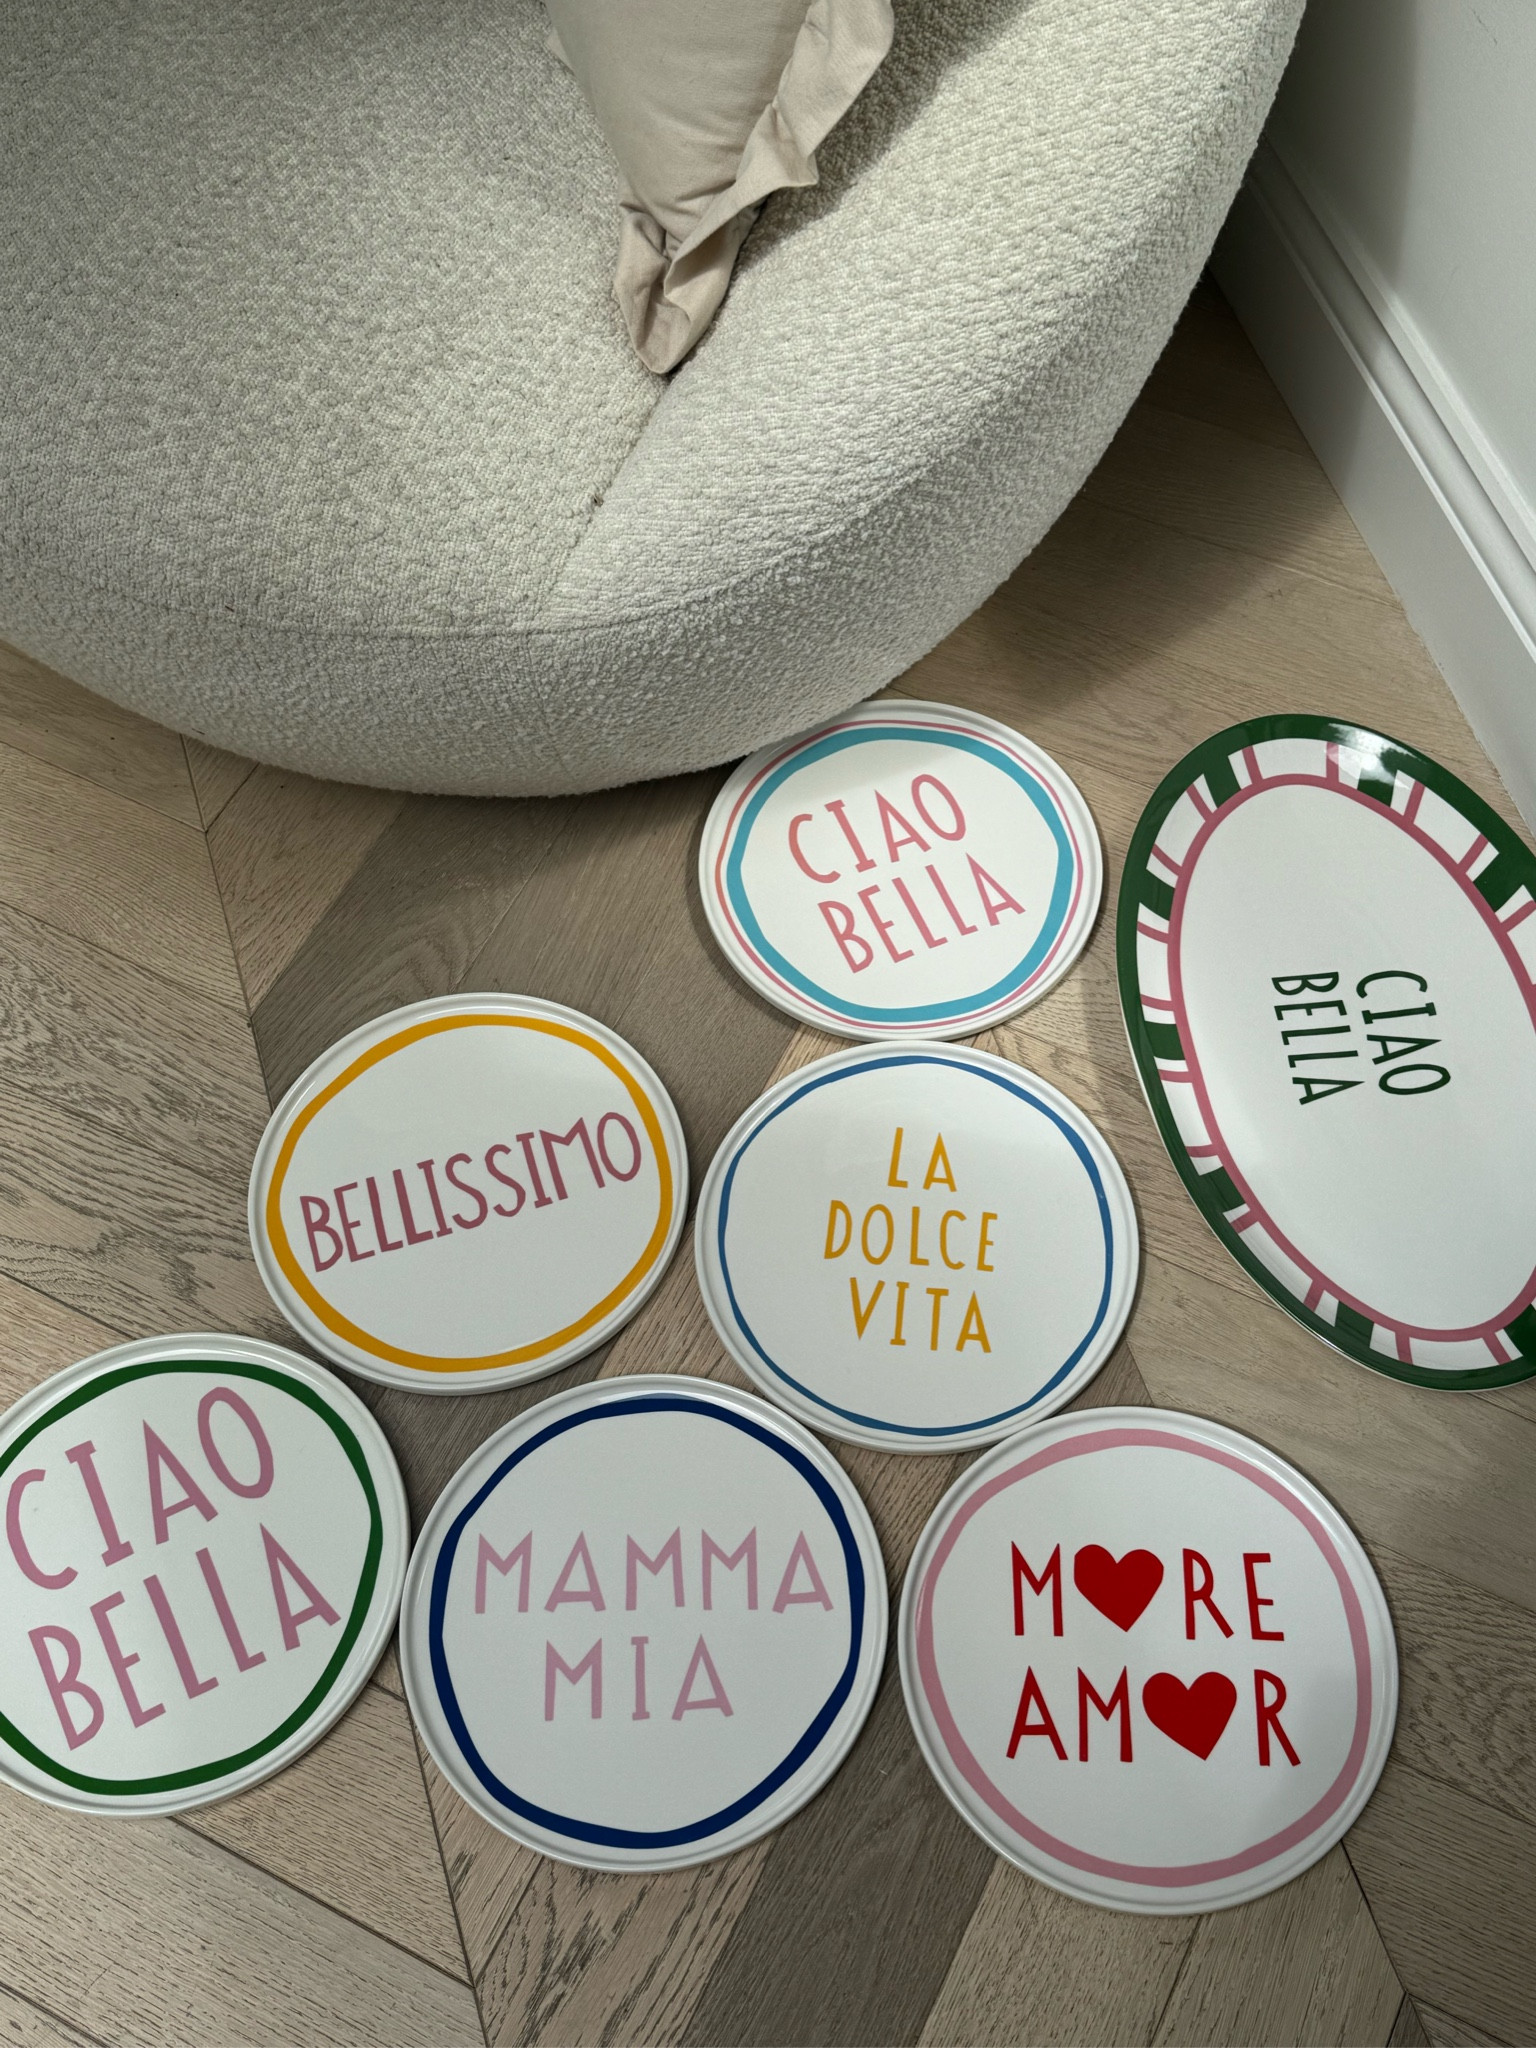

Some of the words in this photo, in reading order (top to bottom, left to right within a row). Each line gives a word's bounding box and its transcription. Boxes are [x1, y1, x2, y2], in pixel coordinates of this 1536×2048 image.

[788, 774, 966, 884] CIAO
[818, 855, 1026, 974] BELLA
[1271, 971, 1364, 1106] BELLA
[1356, 969, 1451, 1096] CIAO
[299, 1111, 643, 1273] BELLISSIMO
[887, 1127, 958, 1193] LA
[823, 1199, 998, 1273] DOLCE
[849, 1276, 992, 1354] VITA
[5, 1386, 275, 1590] CIAO
[474, 1528, 834, 1615] MAMMA
[27, 1523, 342, 1749] BELLA
[544, 1636, 734, 1722] MIA
